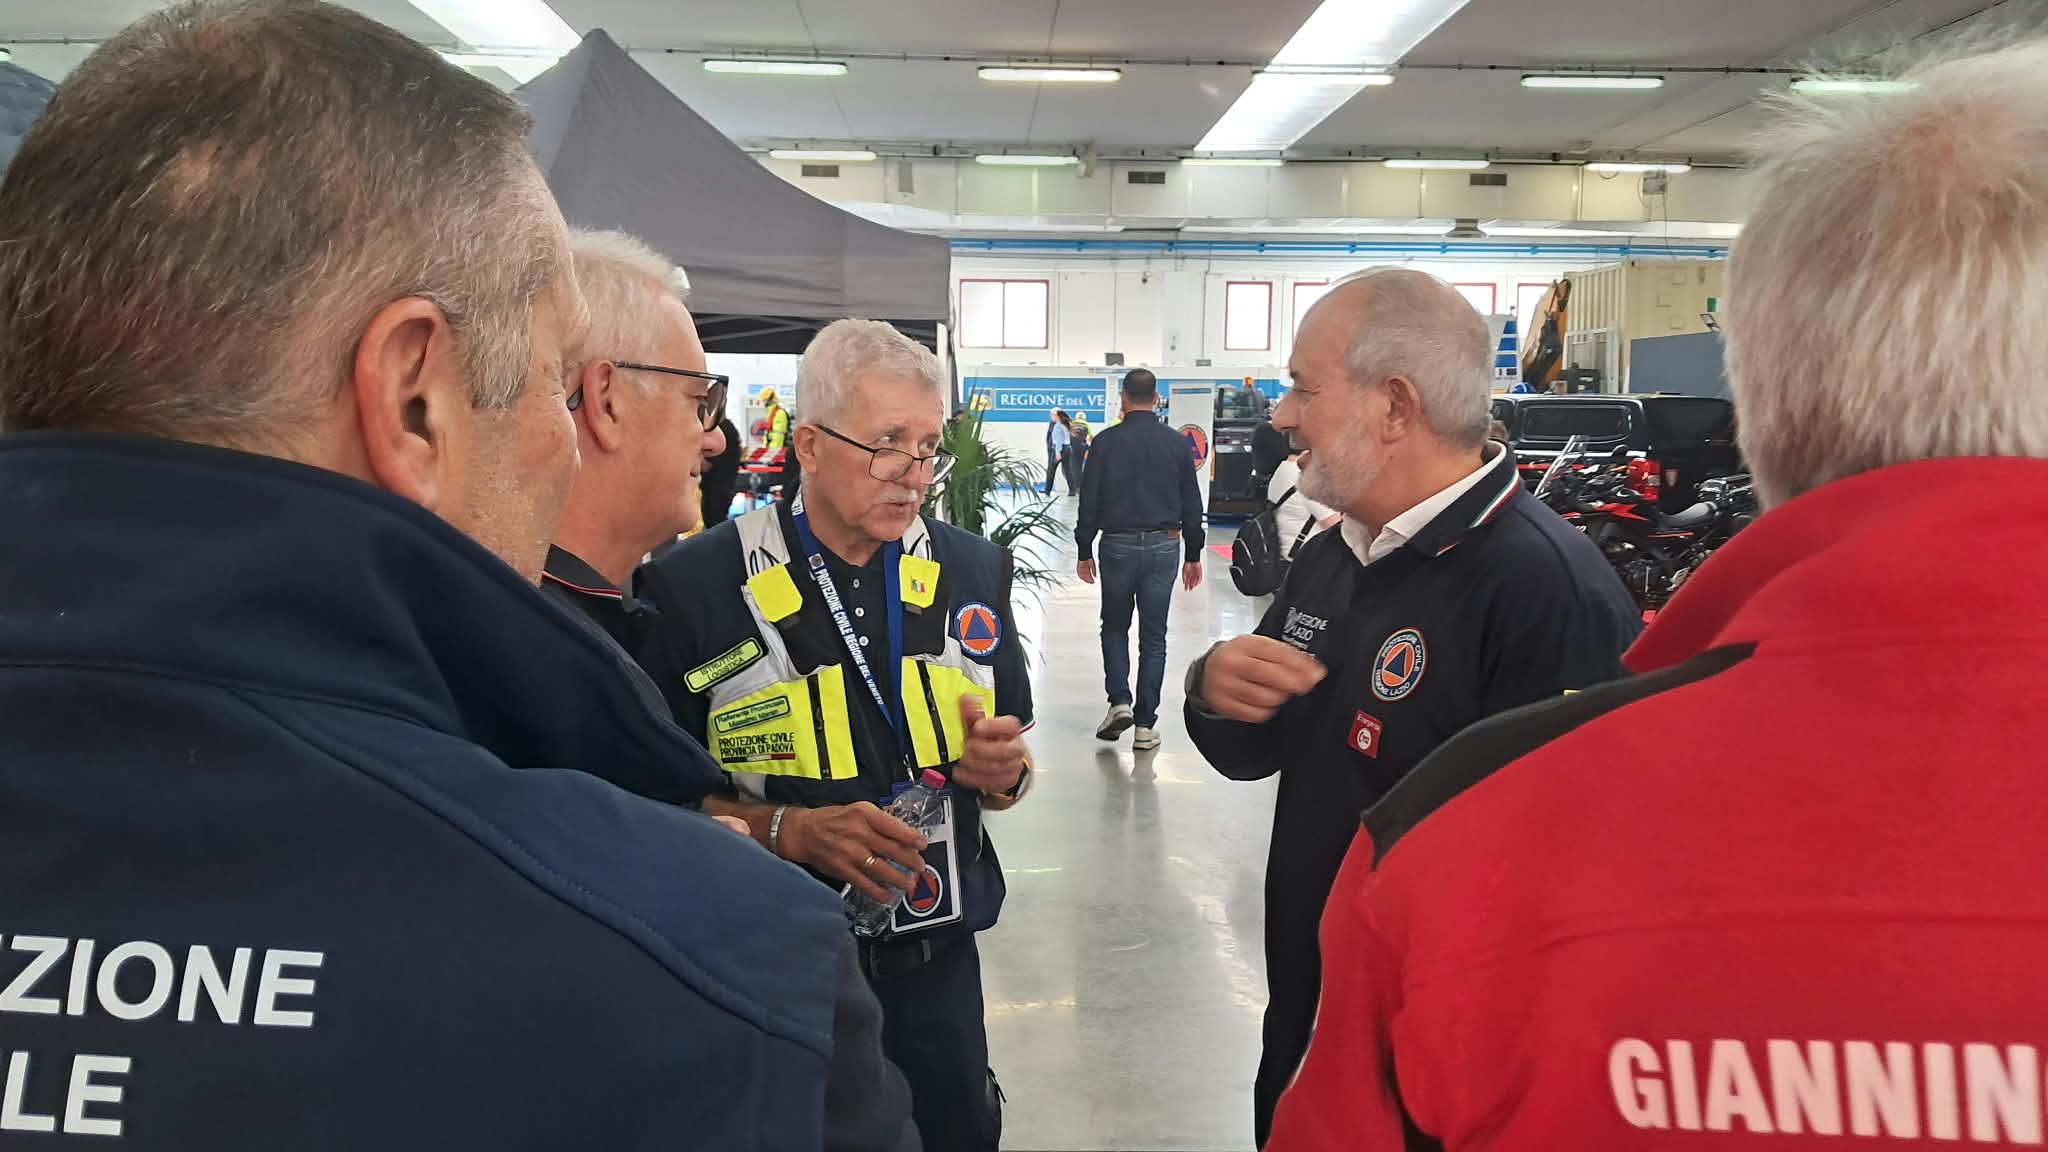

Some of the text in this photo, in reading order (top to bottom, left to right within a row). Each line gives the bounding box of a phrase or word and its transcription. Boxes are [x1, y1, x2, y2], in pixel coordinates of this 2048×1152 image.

[1000, 393, 1065, 406] REGIONE
[815, 568, 843, 613] PROTEZIONE
[833, 611, 853, 635] CIVILE
[843, 633, 866, 666] REGIONE
[858, 664, 873, 680] DEL
[718, 732, 795, 749] PROTEZIONE CIVILE
[720, 742, 794, 757] PROVINCIA DI PADOVA
[0, 934, 324, 1027] ZIONE
[1608, 1036, 2048, 1147] GIANNIN
